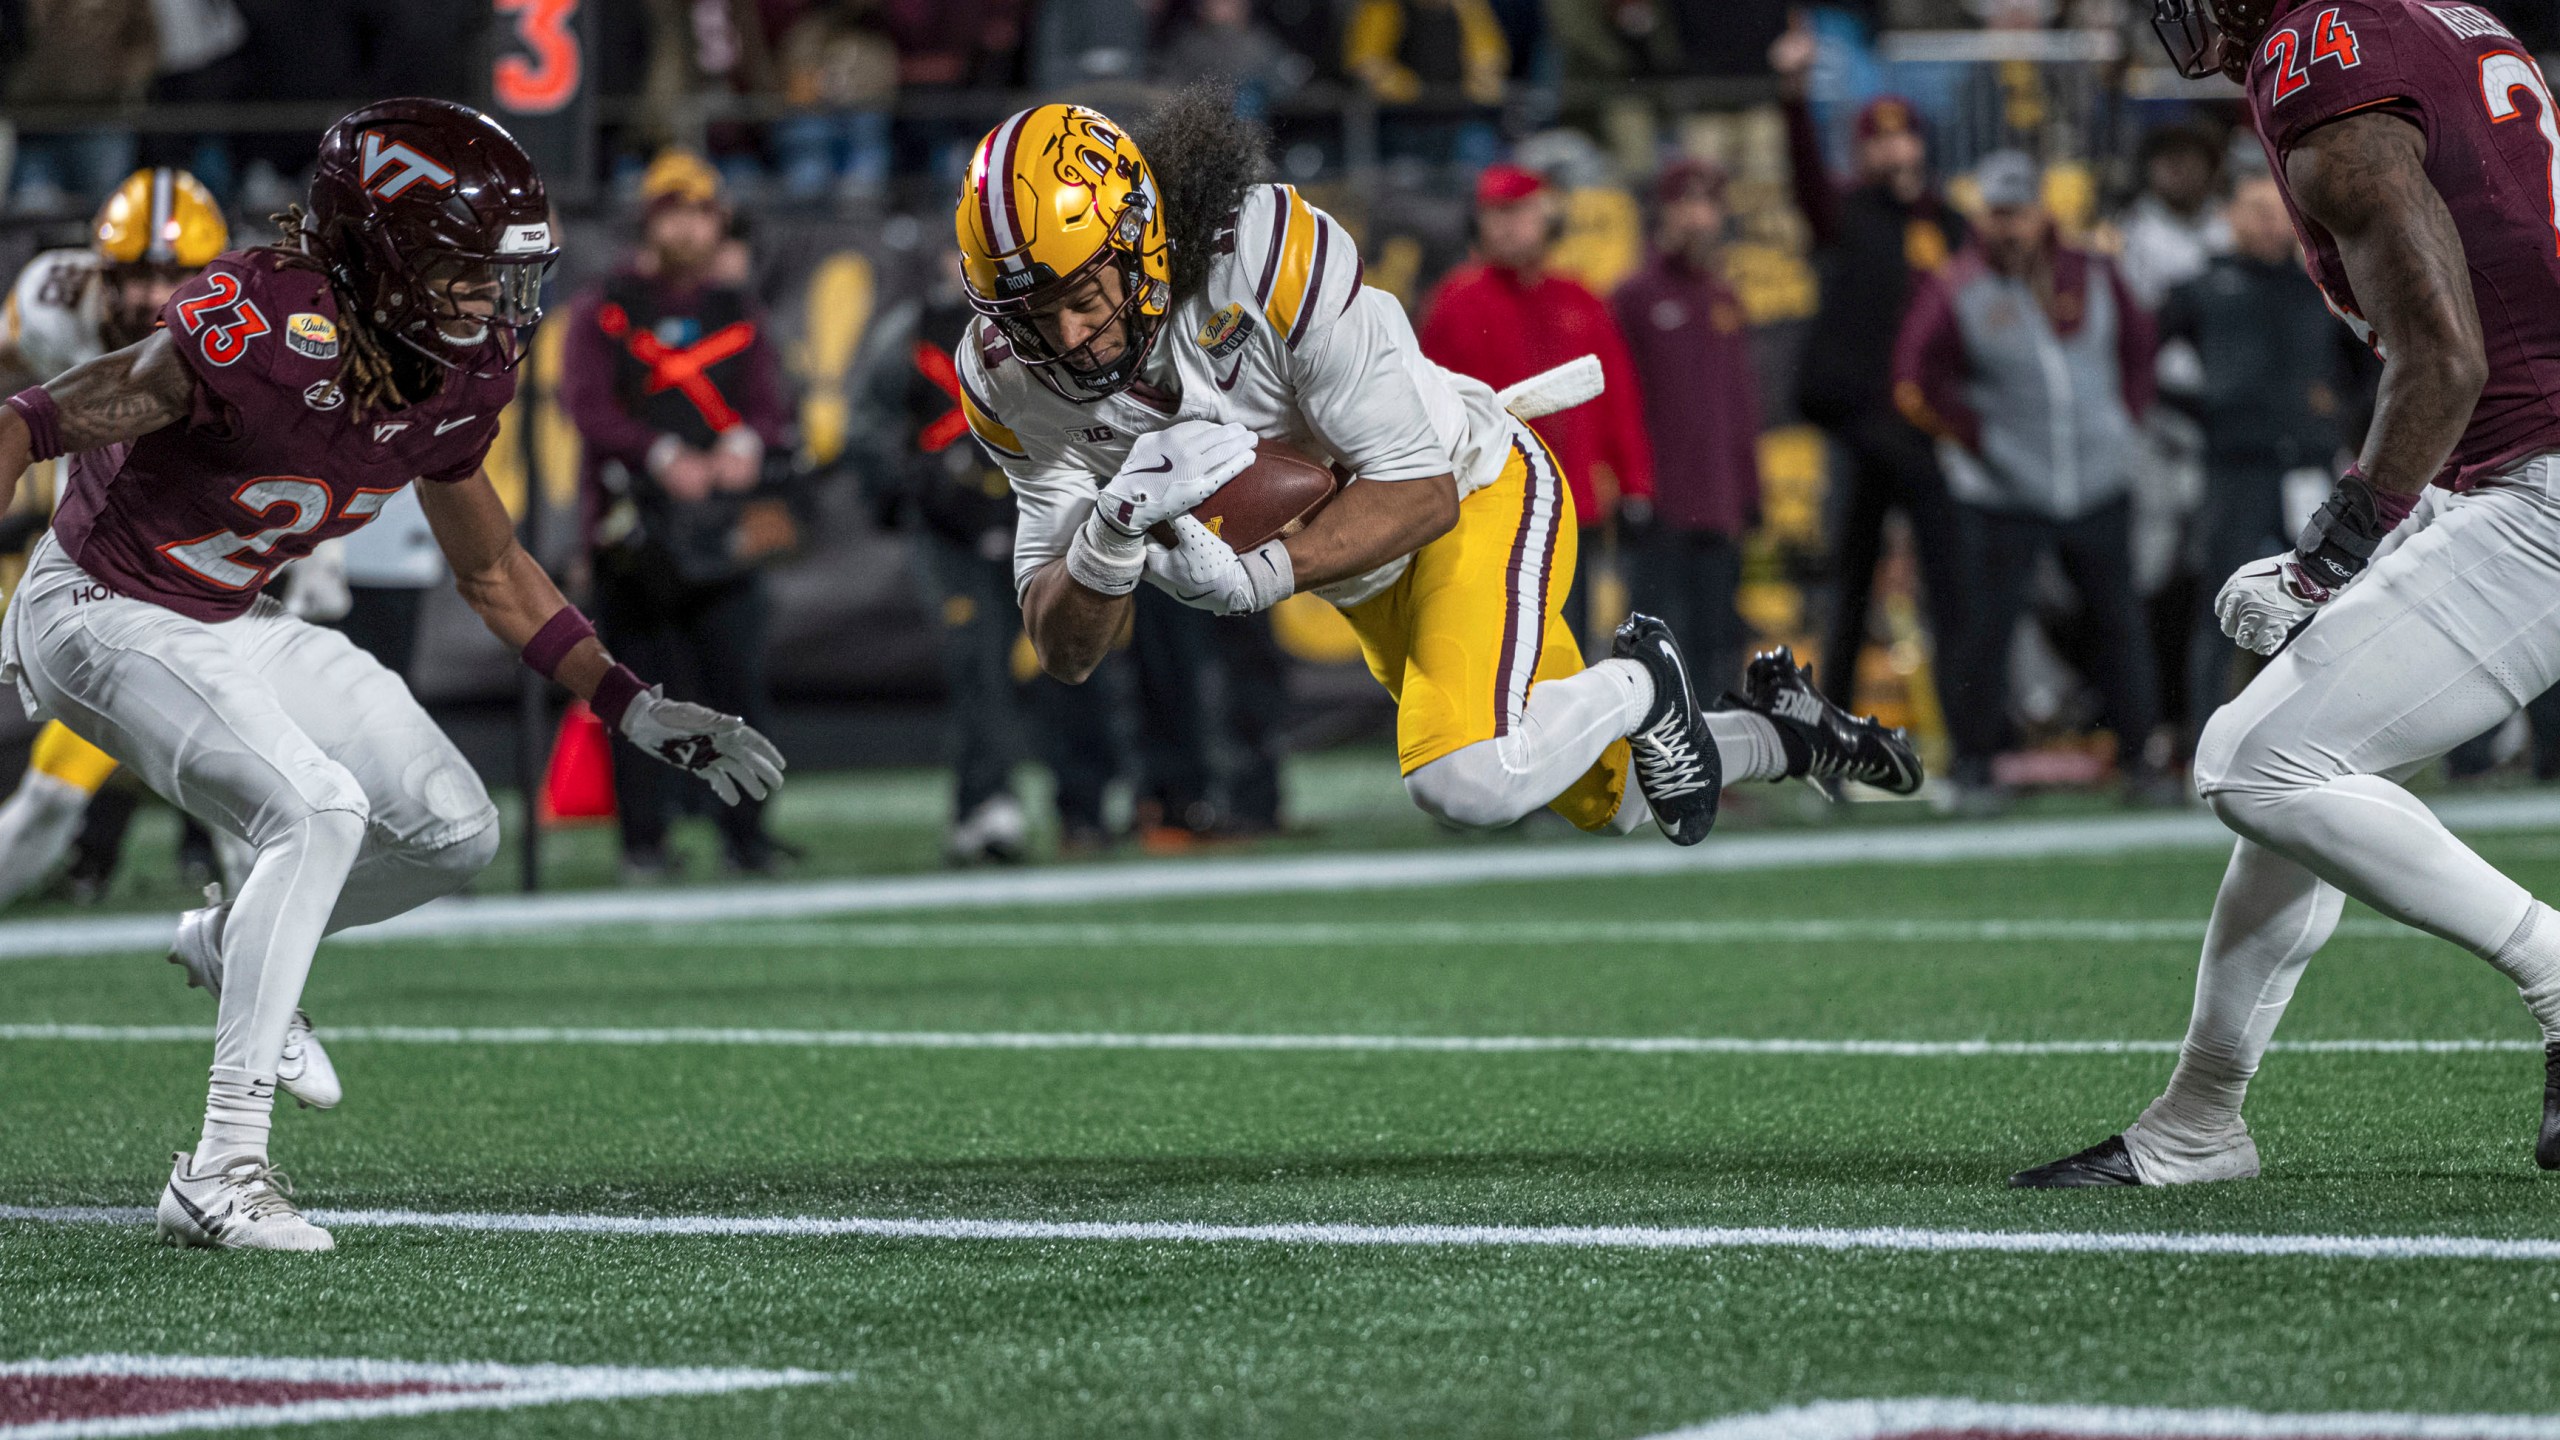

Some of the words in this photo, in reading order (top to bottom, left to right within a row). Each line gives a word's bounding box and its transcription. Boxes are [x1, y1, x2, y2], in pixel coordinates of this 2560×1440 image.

[492, 0, 581, 114] 3
[2264, 8, 2361, 107] 24
[360, 130, 456, 203] VT
[521, 230, 545, 242] TECH
[1006, 271, 1035, 291] ROW
[176, 271, 272, 367] 23
[1221, 327, 1252, 353] BOWL
[373, 423, 410, 443] VT
[1771, 687, 1823, 727] NIKE
